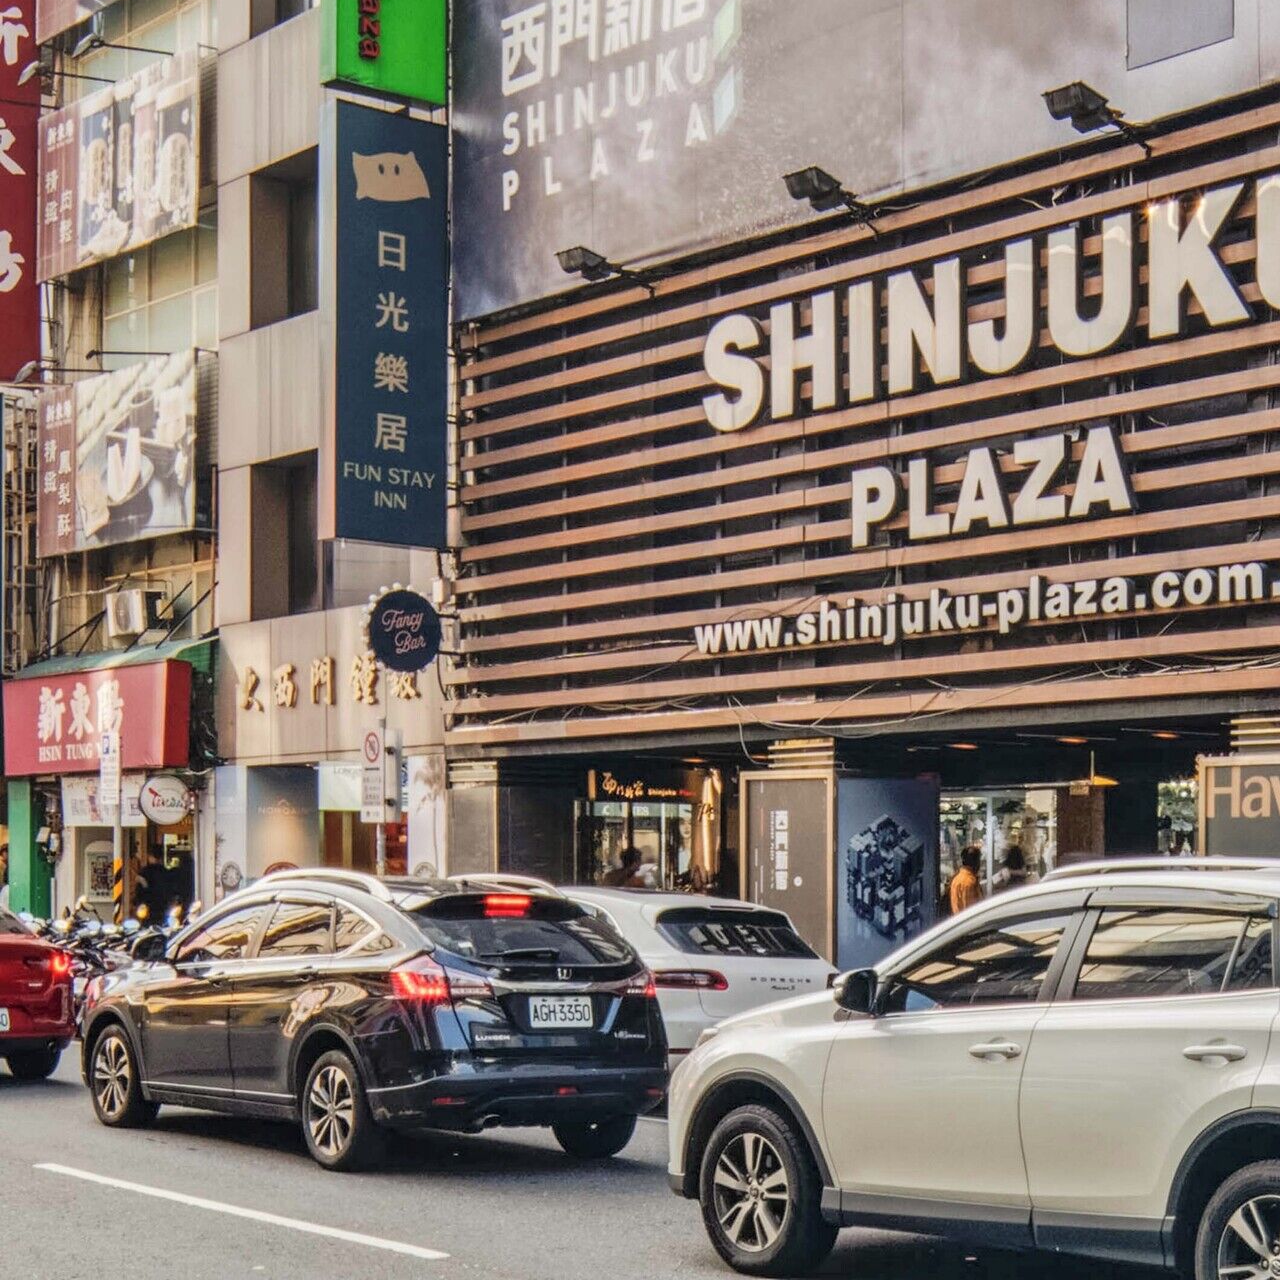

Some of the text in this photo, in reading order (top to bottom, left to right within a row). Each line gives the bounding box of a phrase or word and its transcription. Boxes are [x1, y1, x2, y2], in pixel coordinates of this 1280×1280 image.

[502, 35, 712, 157] SHINJUKU
[502, 101, 708, 211] PLAZA
[374, 230, 410, 454] 日光樂居
[343, 461, 435, 489] FUN STAY
[850, 424, 1134, 548] PLAZA
[374, 491, 407, 510] INN
[381, 609, 424, 633] Fancy
[394, 630, 426, 654] Bar
[38, 680, 124, 743] 新東陽
[39, 745, 62, 763] HSIN
[66, 743, 94, 760] TUNG
